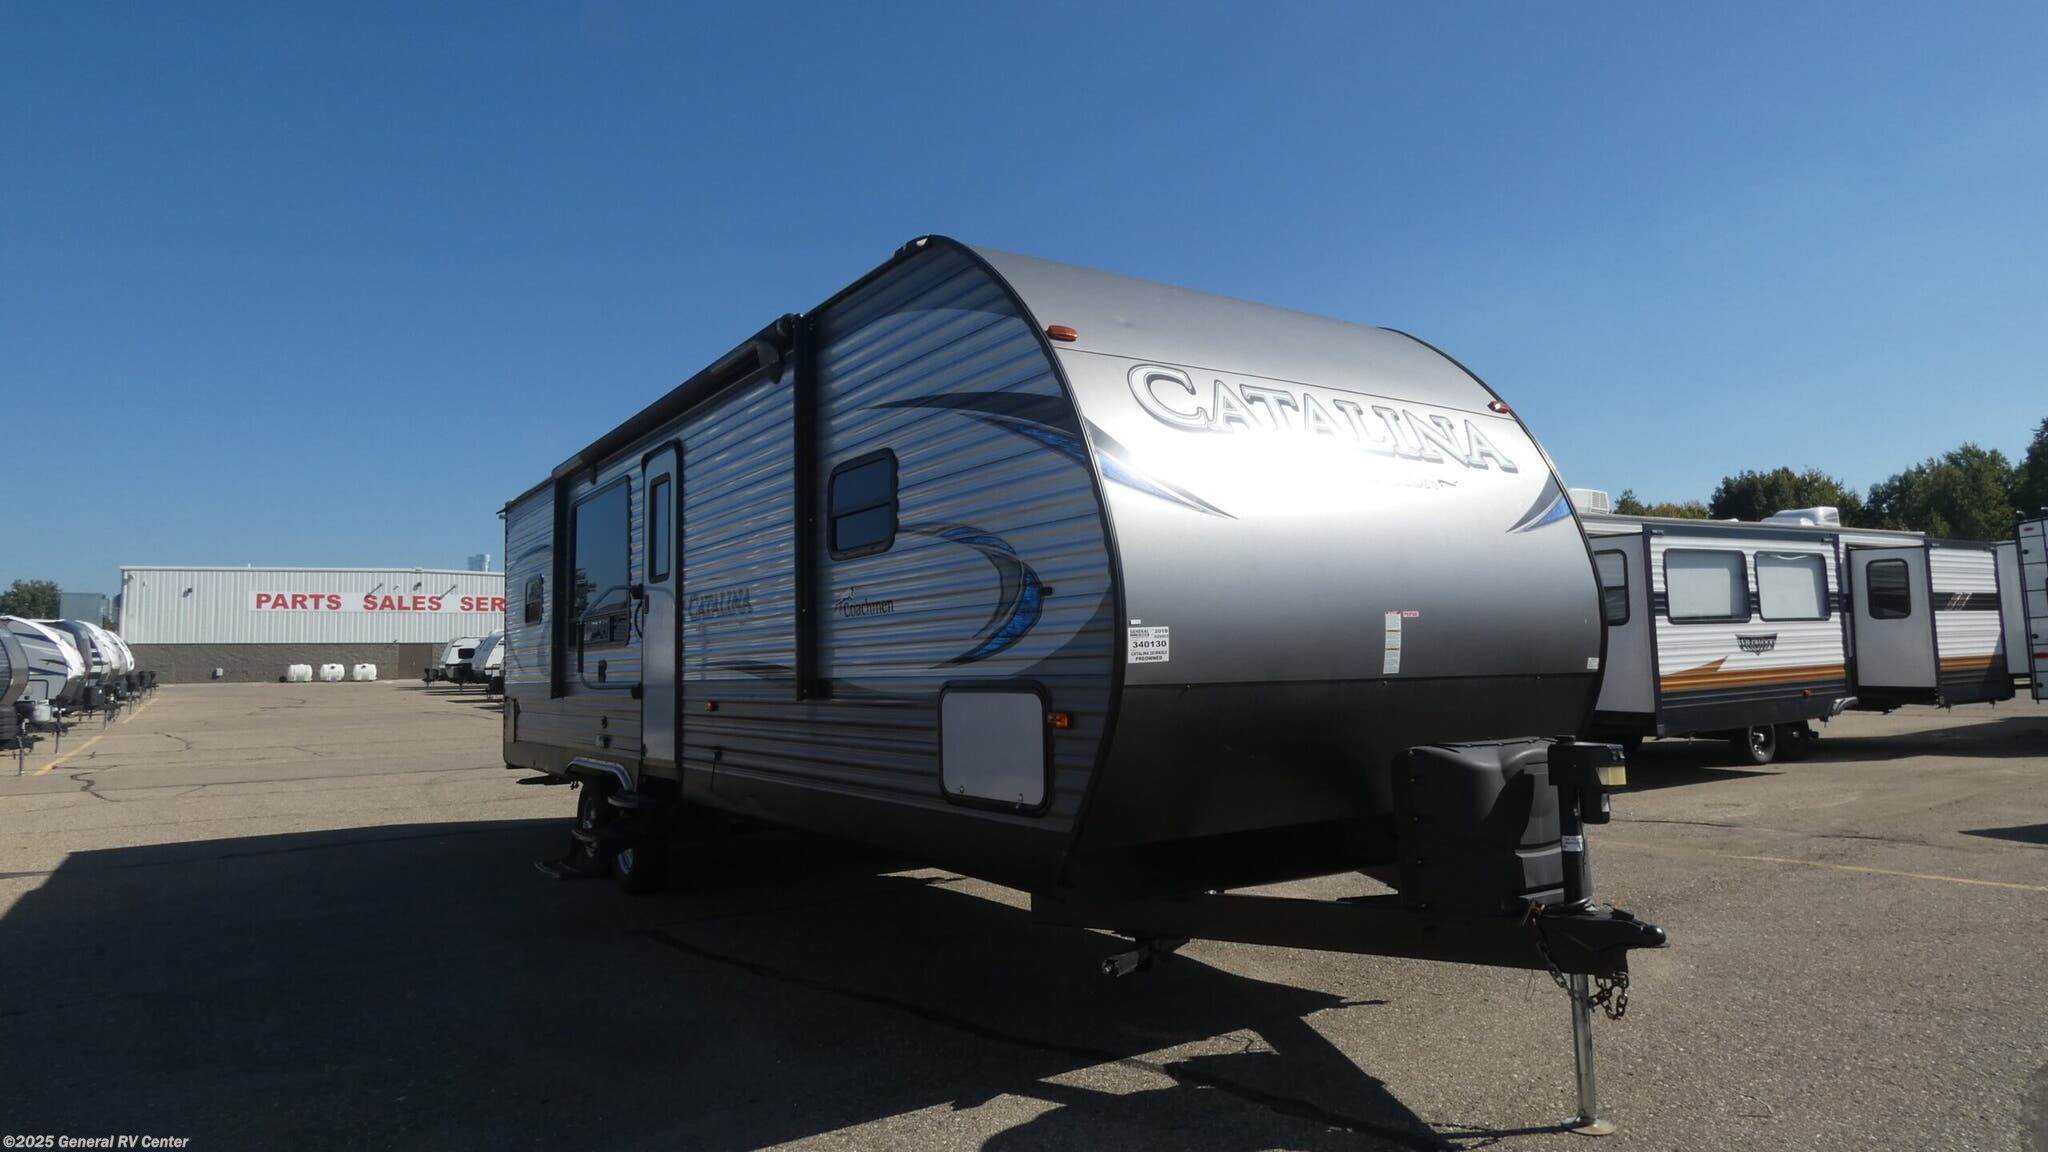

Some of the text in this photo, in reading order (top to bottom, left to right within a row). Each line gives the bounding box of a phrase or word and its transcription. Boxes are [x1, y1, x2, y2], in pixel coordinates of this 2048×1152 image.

[1127, 363, 1519, 474] CATALINA
[256, 593, 342, 611] PARTS
[363, 595, 442, 612] SALES
[843, 598, 895, 618] Coachmen
[1132, 640, 1167, 649] 340130
